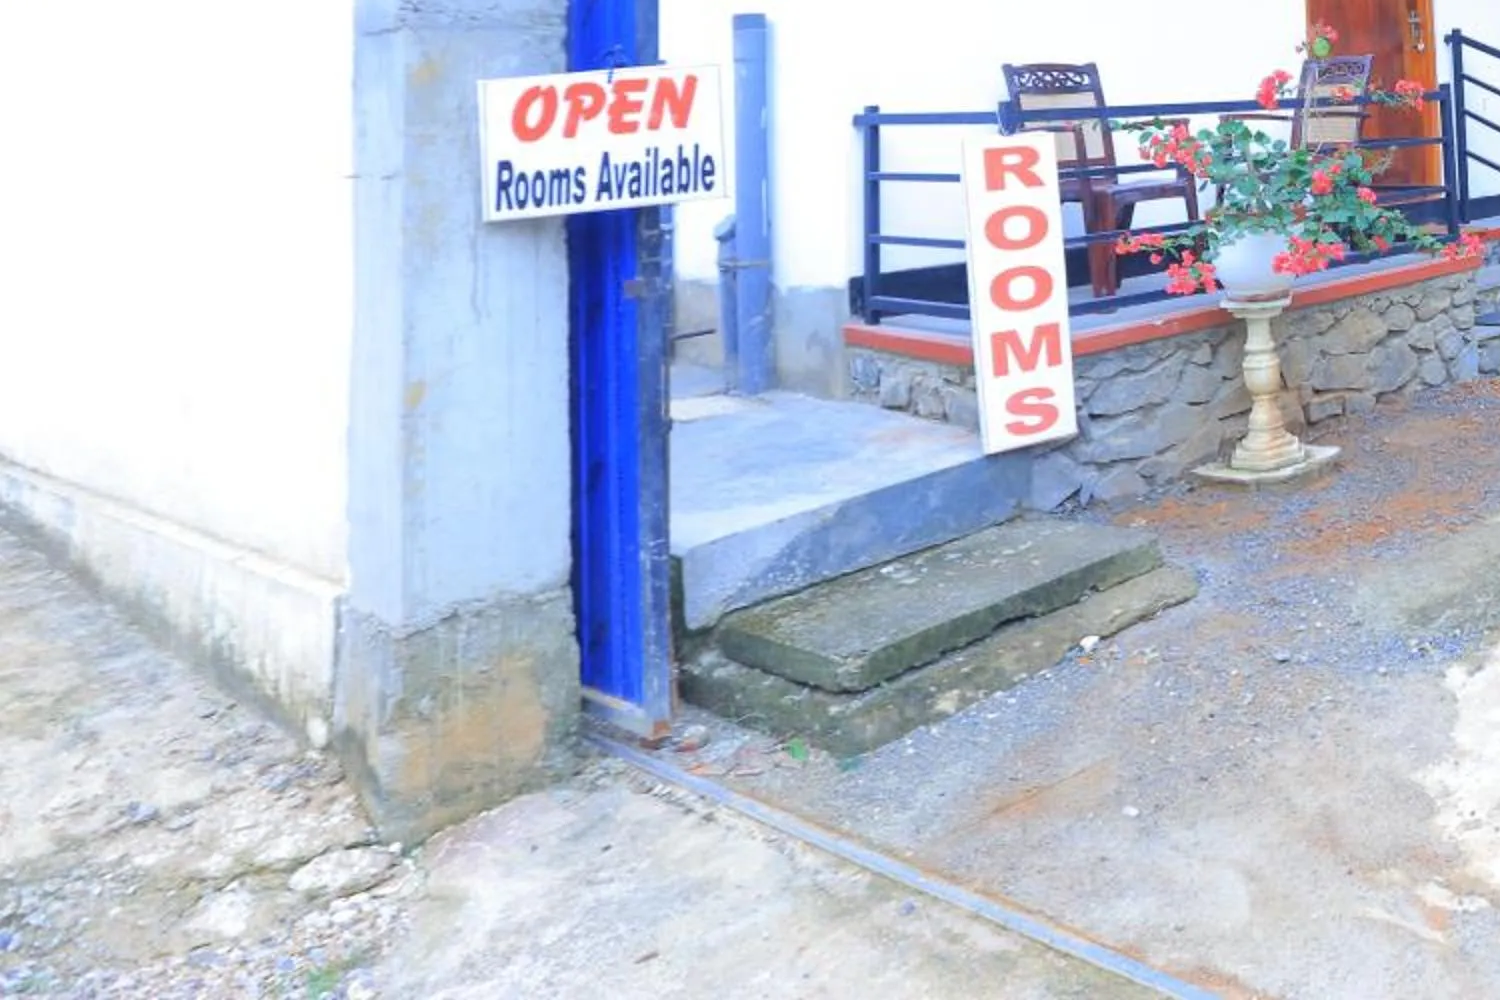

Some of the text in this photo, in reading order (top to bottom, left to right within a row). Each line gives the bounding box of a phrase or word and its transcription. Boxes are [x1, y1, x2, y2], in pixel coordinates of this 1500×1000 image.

[511, 75, 698, 143] OPEN
[496, 143, 716, 212] Rooms Available
[983, 146, 1062, 436] ROOMS
